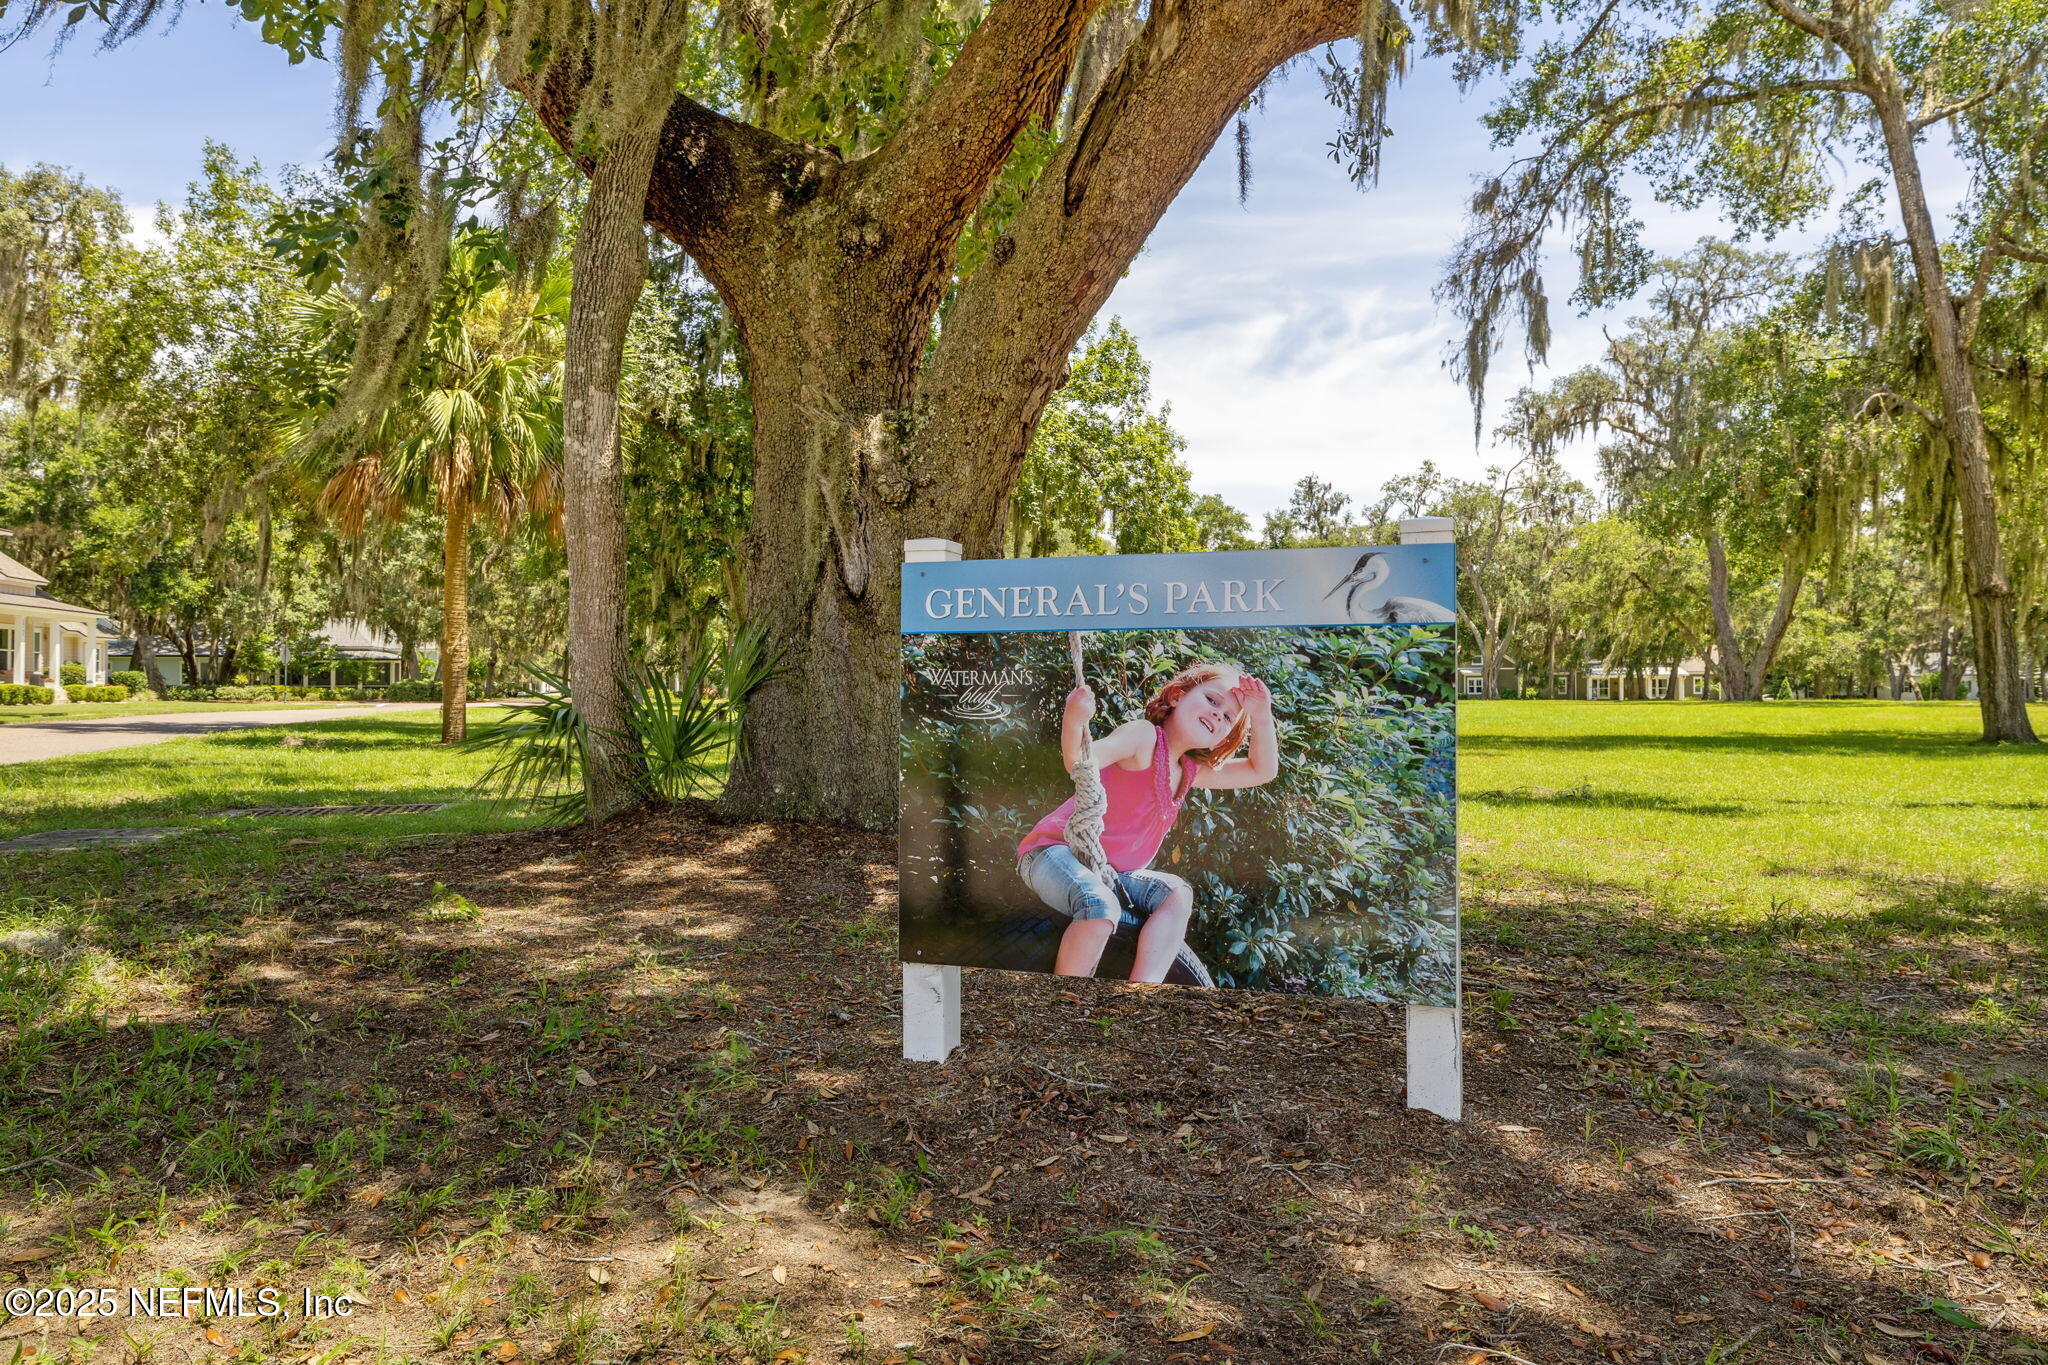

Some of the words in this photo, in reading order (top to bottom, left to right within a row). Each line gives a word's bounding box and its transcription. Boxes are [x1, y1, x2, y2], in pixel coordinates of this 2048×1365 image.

[924, 582, 1150, 620] GENERAL'S
[1162, 576, 1287, 615] PARK
[957, 681, 1008, 709] bluff
